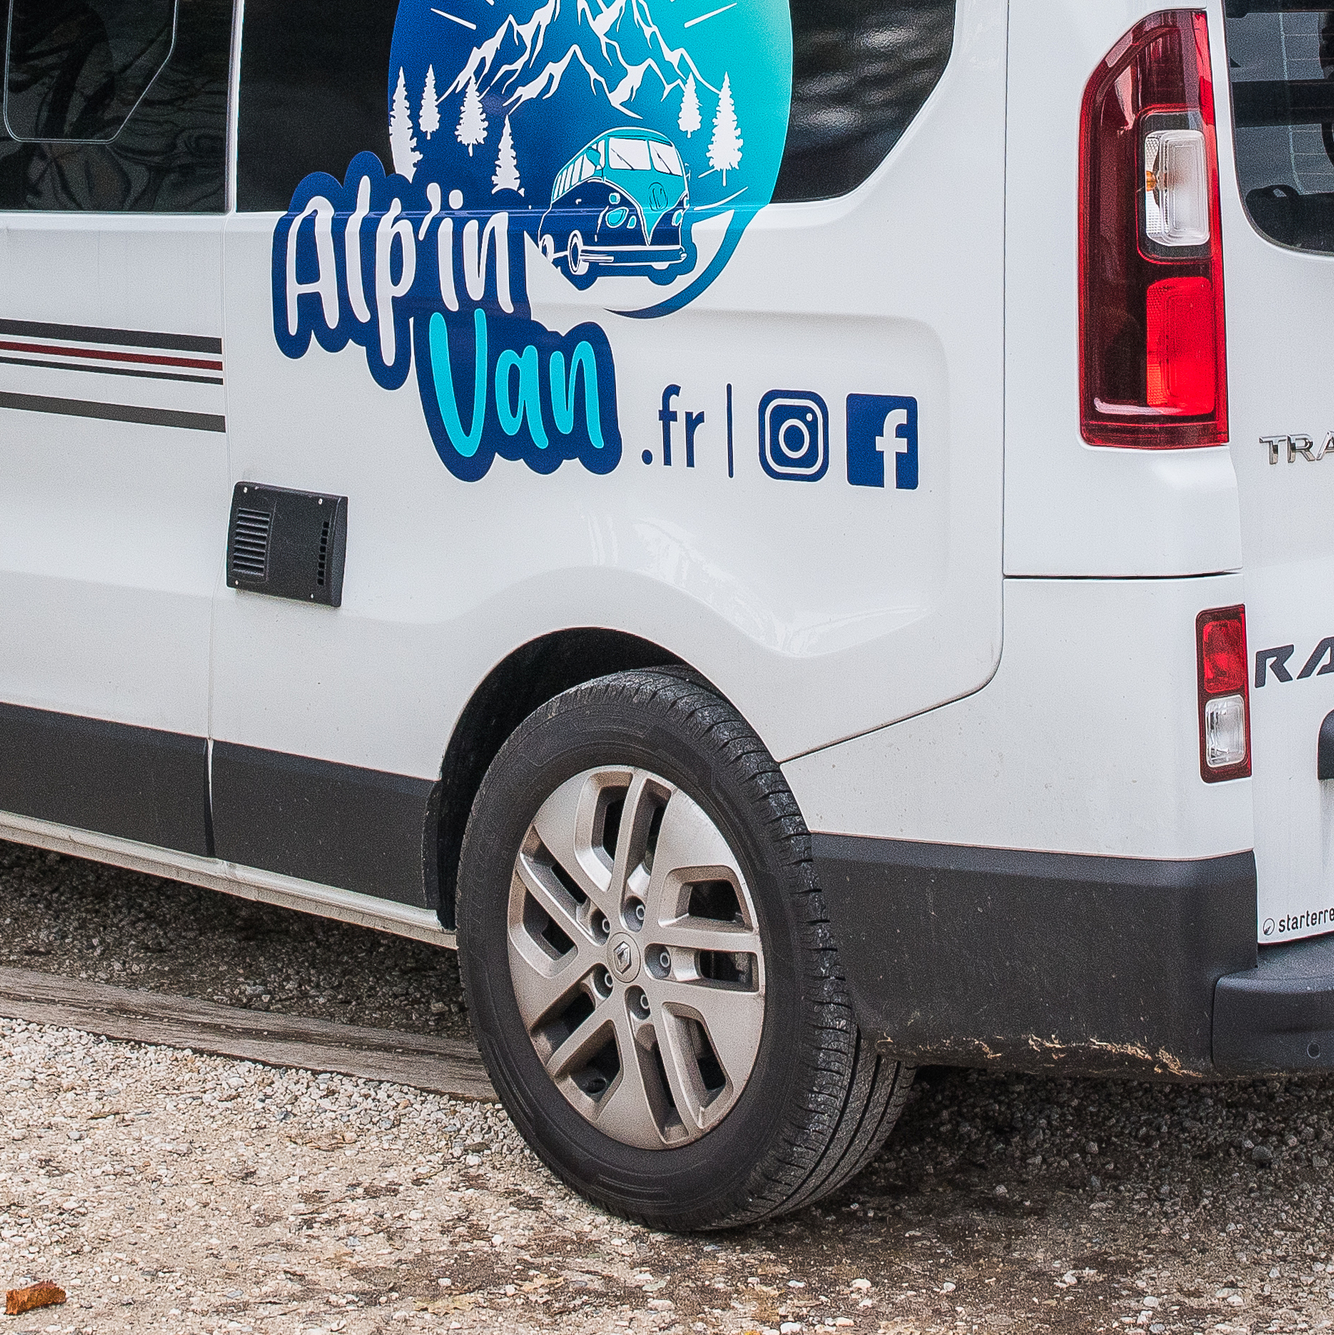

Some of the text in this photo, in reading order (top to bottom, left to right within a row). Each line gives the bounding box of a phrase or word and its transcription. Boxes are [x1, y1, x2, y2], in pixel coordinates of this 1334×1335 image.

[286, 175, 514, 367] Alp'in
[429, 308, 705, 468] Van .fr
[1279, 907, 1334, 933] starterre
